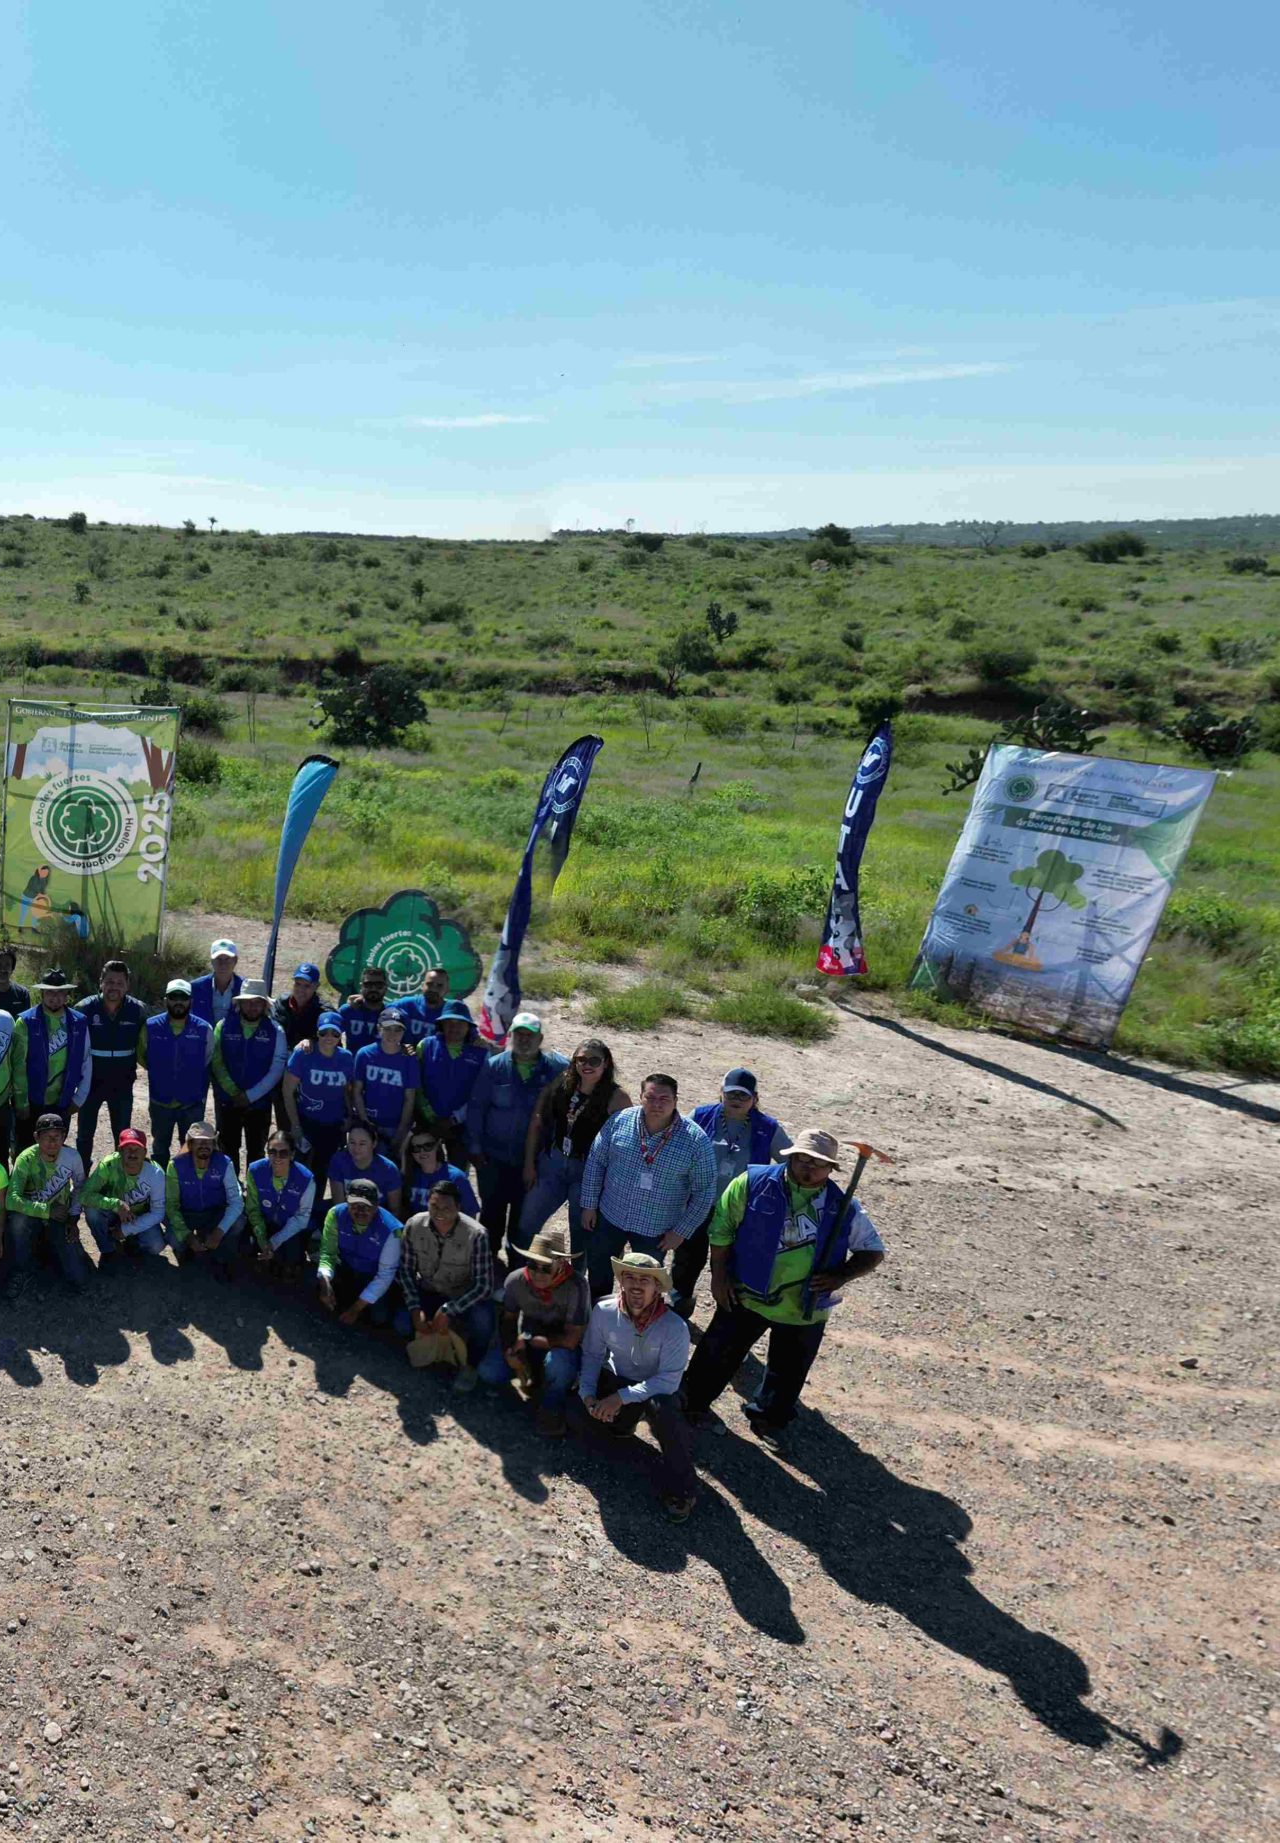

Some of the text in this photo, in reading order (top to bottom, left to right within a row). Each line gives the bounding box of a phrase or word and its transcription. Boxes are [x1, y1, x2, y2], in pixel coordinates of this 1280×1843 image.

[34, 774, 90, 828] Árboles fuertes
[1016, 818, 1120, 842] árboles en la ciudad
[1028, 812, 1080, 826] Beneficios
[1097, 822, 1112, 832] los
[70, 818, 134, 869] Huellas Gigantes
[138, 792, 170, 883] 2025
[366, 930, 412, 966] rboles fuertes
[411, 1019, 435, 1036] UT
[310, 1068, 347, 1086] UTA
[366, 1064, 403, 1086] UTA
